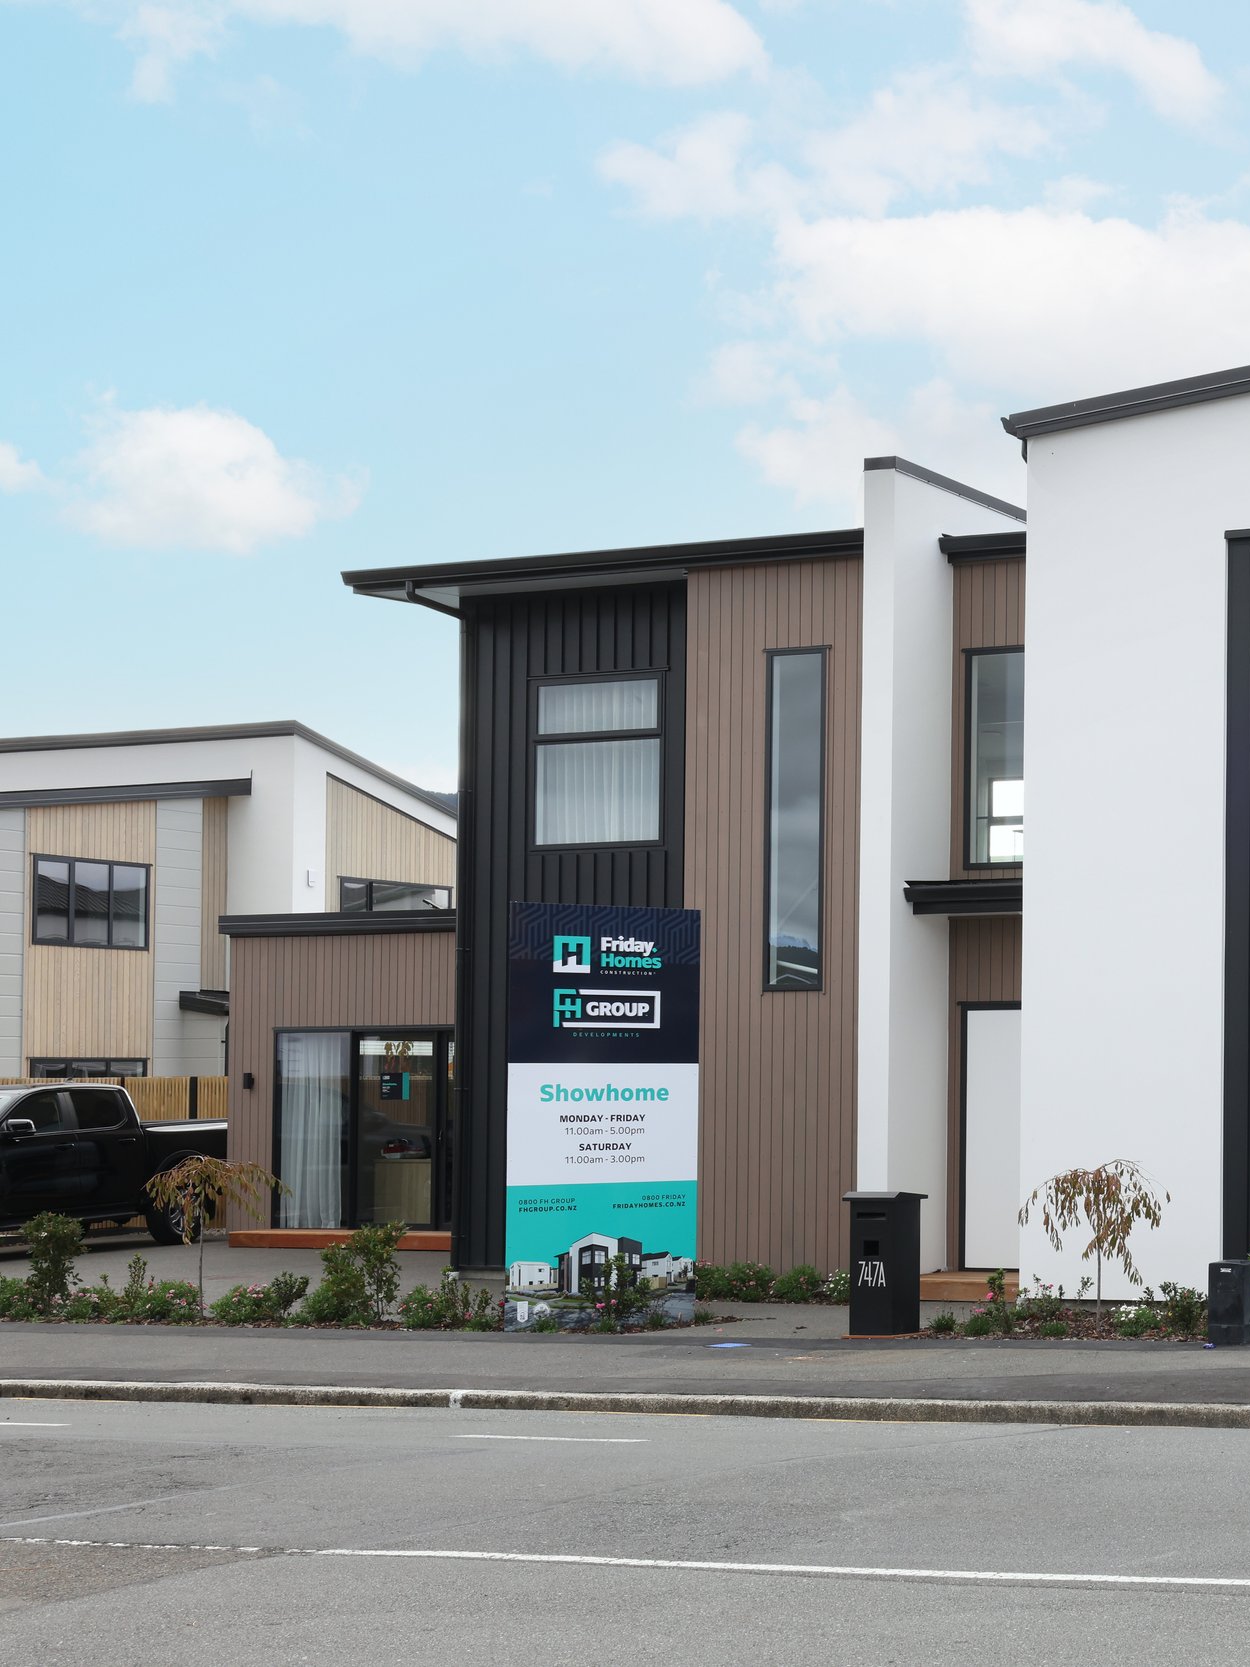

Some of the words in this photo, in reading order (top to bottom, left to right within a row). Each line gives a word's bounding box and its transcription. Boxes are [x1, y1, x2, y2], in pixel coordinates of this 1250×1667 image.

[601, 953, 662, 968] Homes
[586, 1002, 650, 1017] GROUP
[540, 1084, 669, 1102] Showhome
[559, 1115, 604, 1123] MONDAY
[610, 1114, 646, 1122] FRIDAY
[564, 1127, 604, 1136] 11.00am
[610, 1126, 645, 1136] 5.00pm
[579, 1143, 632, 1151] SATURDAY
[564, 1155, 604, 1164] 11.00am
[610, 1154, 645, 1165] 3.00pm
[518, 1205, 577, 1213] FHGROUP.CO.NZ
[612, 1201, 686, 1209] FRIDAYHOMES.CO.NZ
[857, 1261, 886, 1287] 747A
